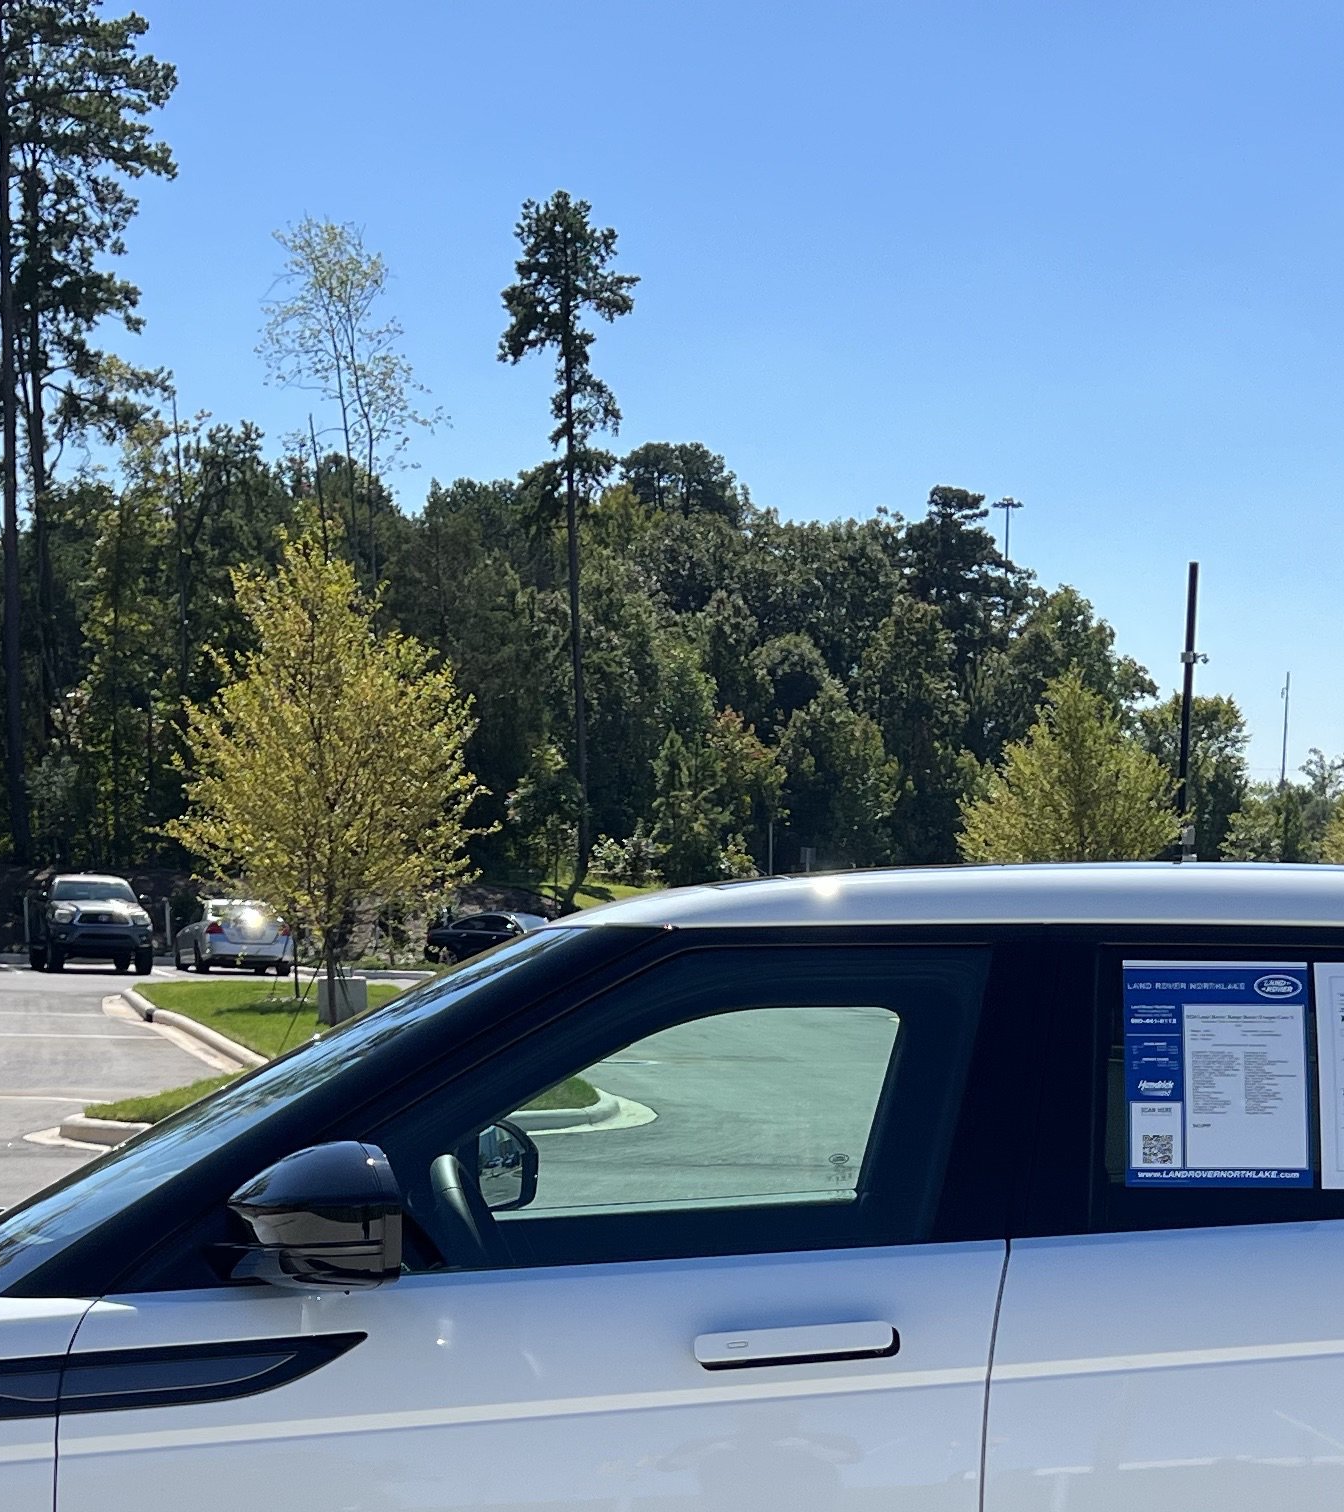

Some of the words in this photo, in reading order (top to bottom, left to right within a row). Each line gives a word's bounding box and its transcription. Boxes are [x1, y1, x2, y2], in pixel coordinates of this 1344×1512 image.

[1127, 982, 1152, 990] LAND
[1155, 982, 1187, 990] ROVER
[1189, 982, 1246, 990] NORTHLAKE
[1137, 1170, 1301, 1180] www.LANDROVERNORTHLAKE.com
